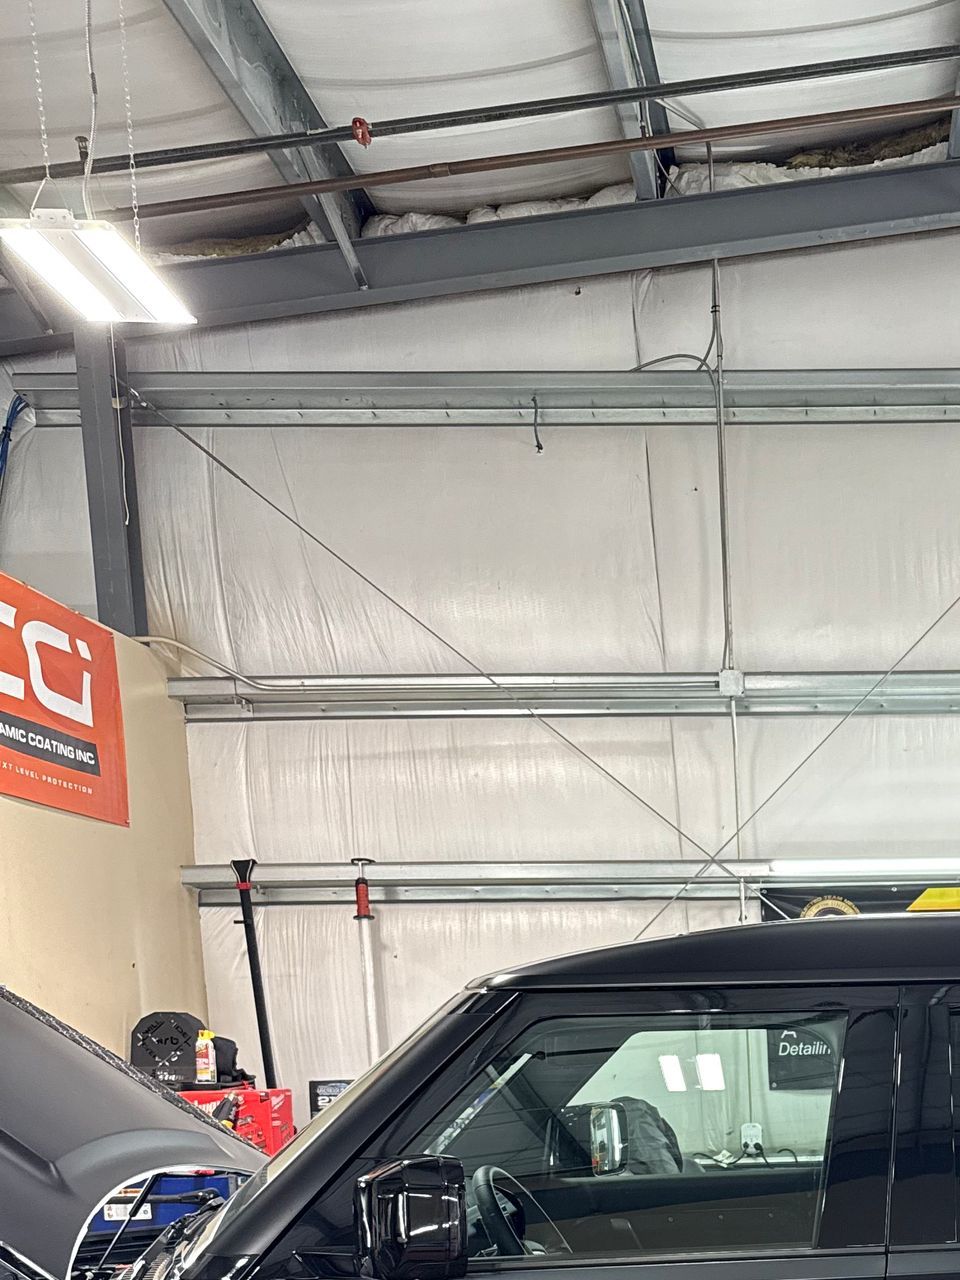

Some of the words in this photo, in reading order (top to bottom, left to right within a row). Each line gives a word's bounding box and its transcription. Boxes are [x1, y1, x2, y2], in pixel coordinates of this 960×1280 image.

[28, 732, 75, 759] COATING
[76, 749, 95, 765] INC
[0, 761, 13, 770] XT
[16, 765, 40, 780] LEVEL
[42, 775, 93, 795] PROTECTION
